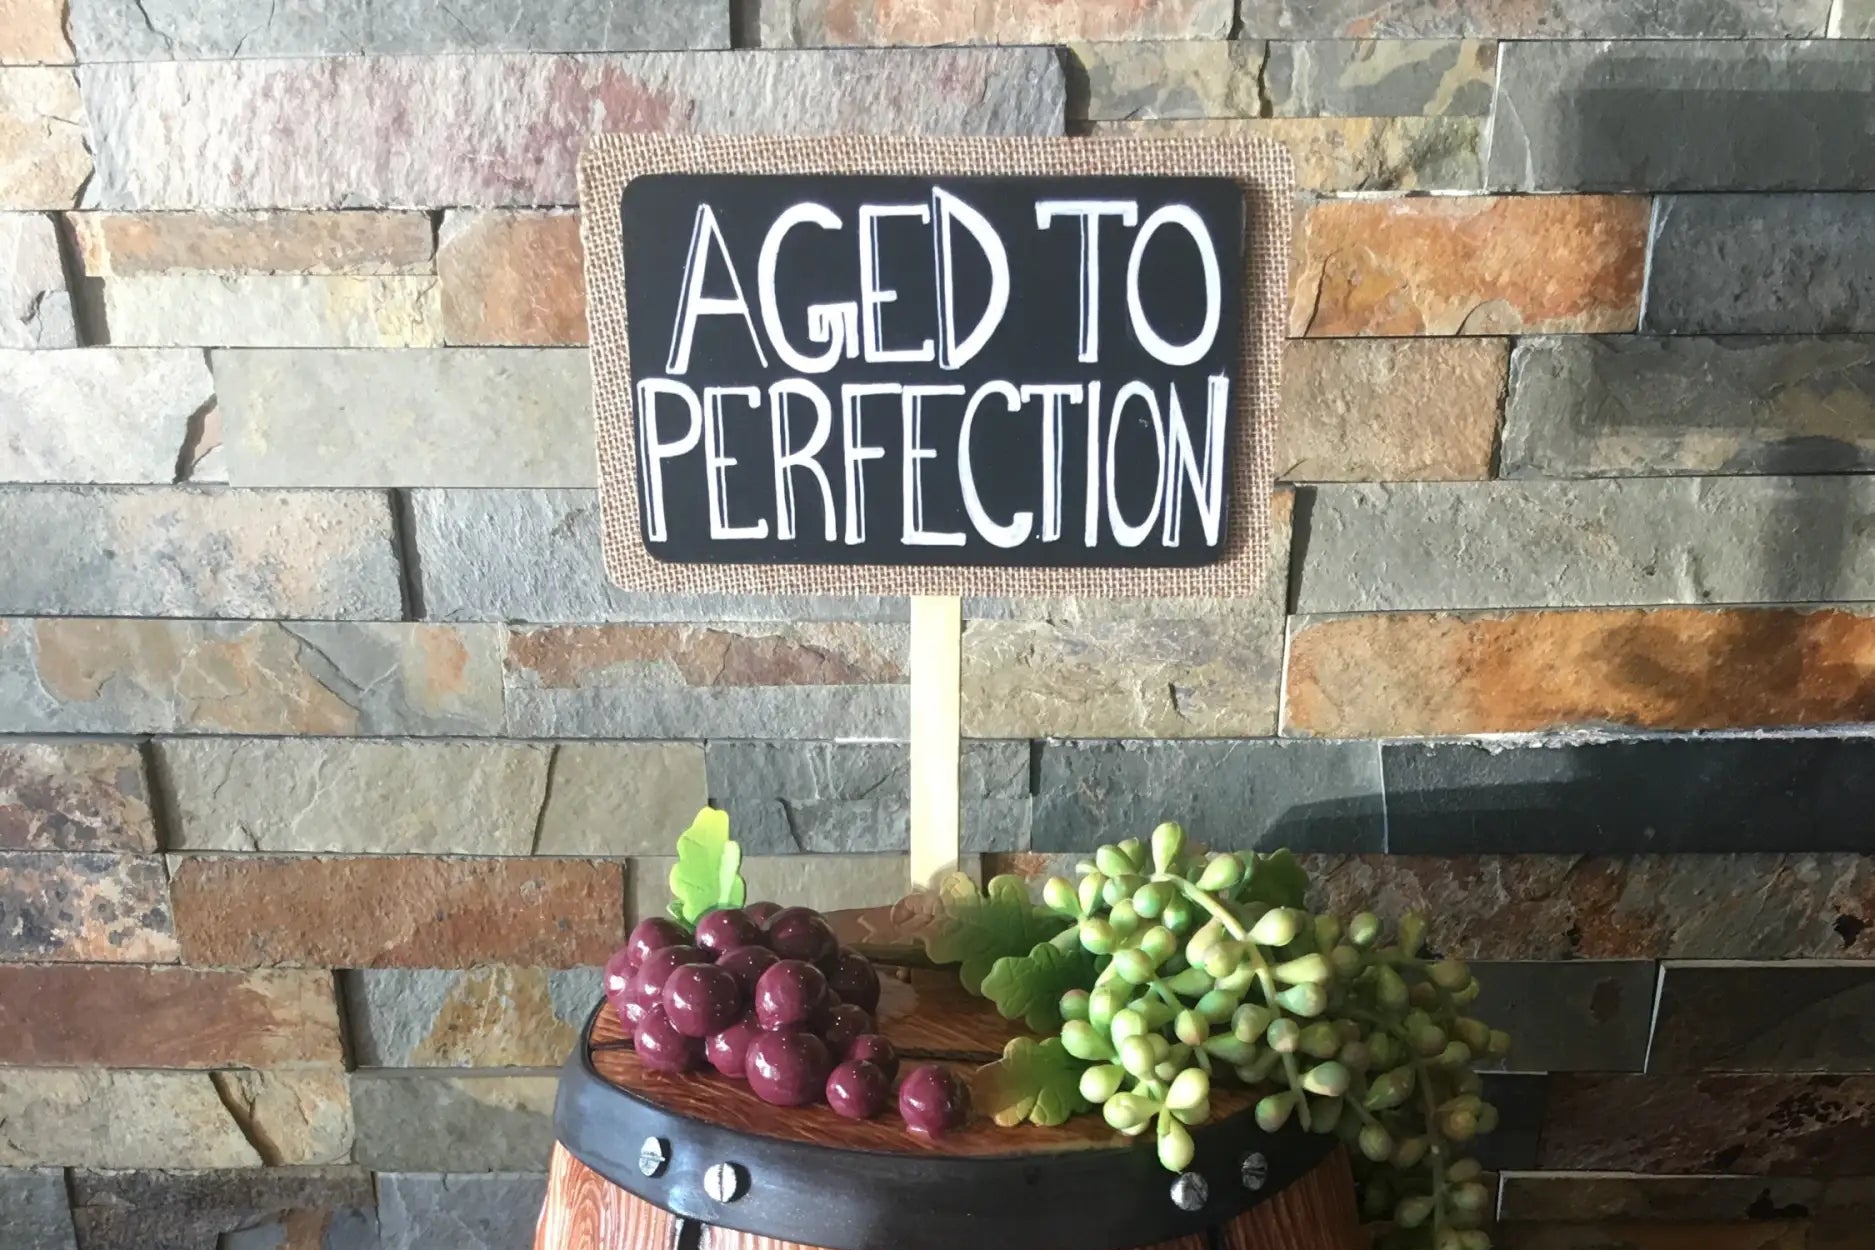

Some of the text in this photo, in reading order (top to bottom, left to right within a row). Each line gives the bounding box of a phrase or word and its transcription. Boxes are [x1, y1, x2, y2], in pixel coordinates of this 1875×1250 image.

[665, 186, 1222, 374] AGED TO
[637, 372, 1229, 548] PERFECTION
